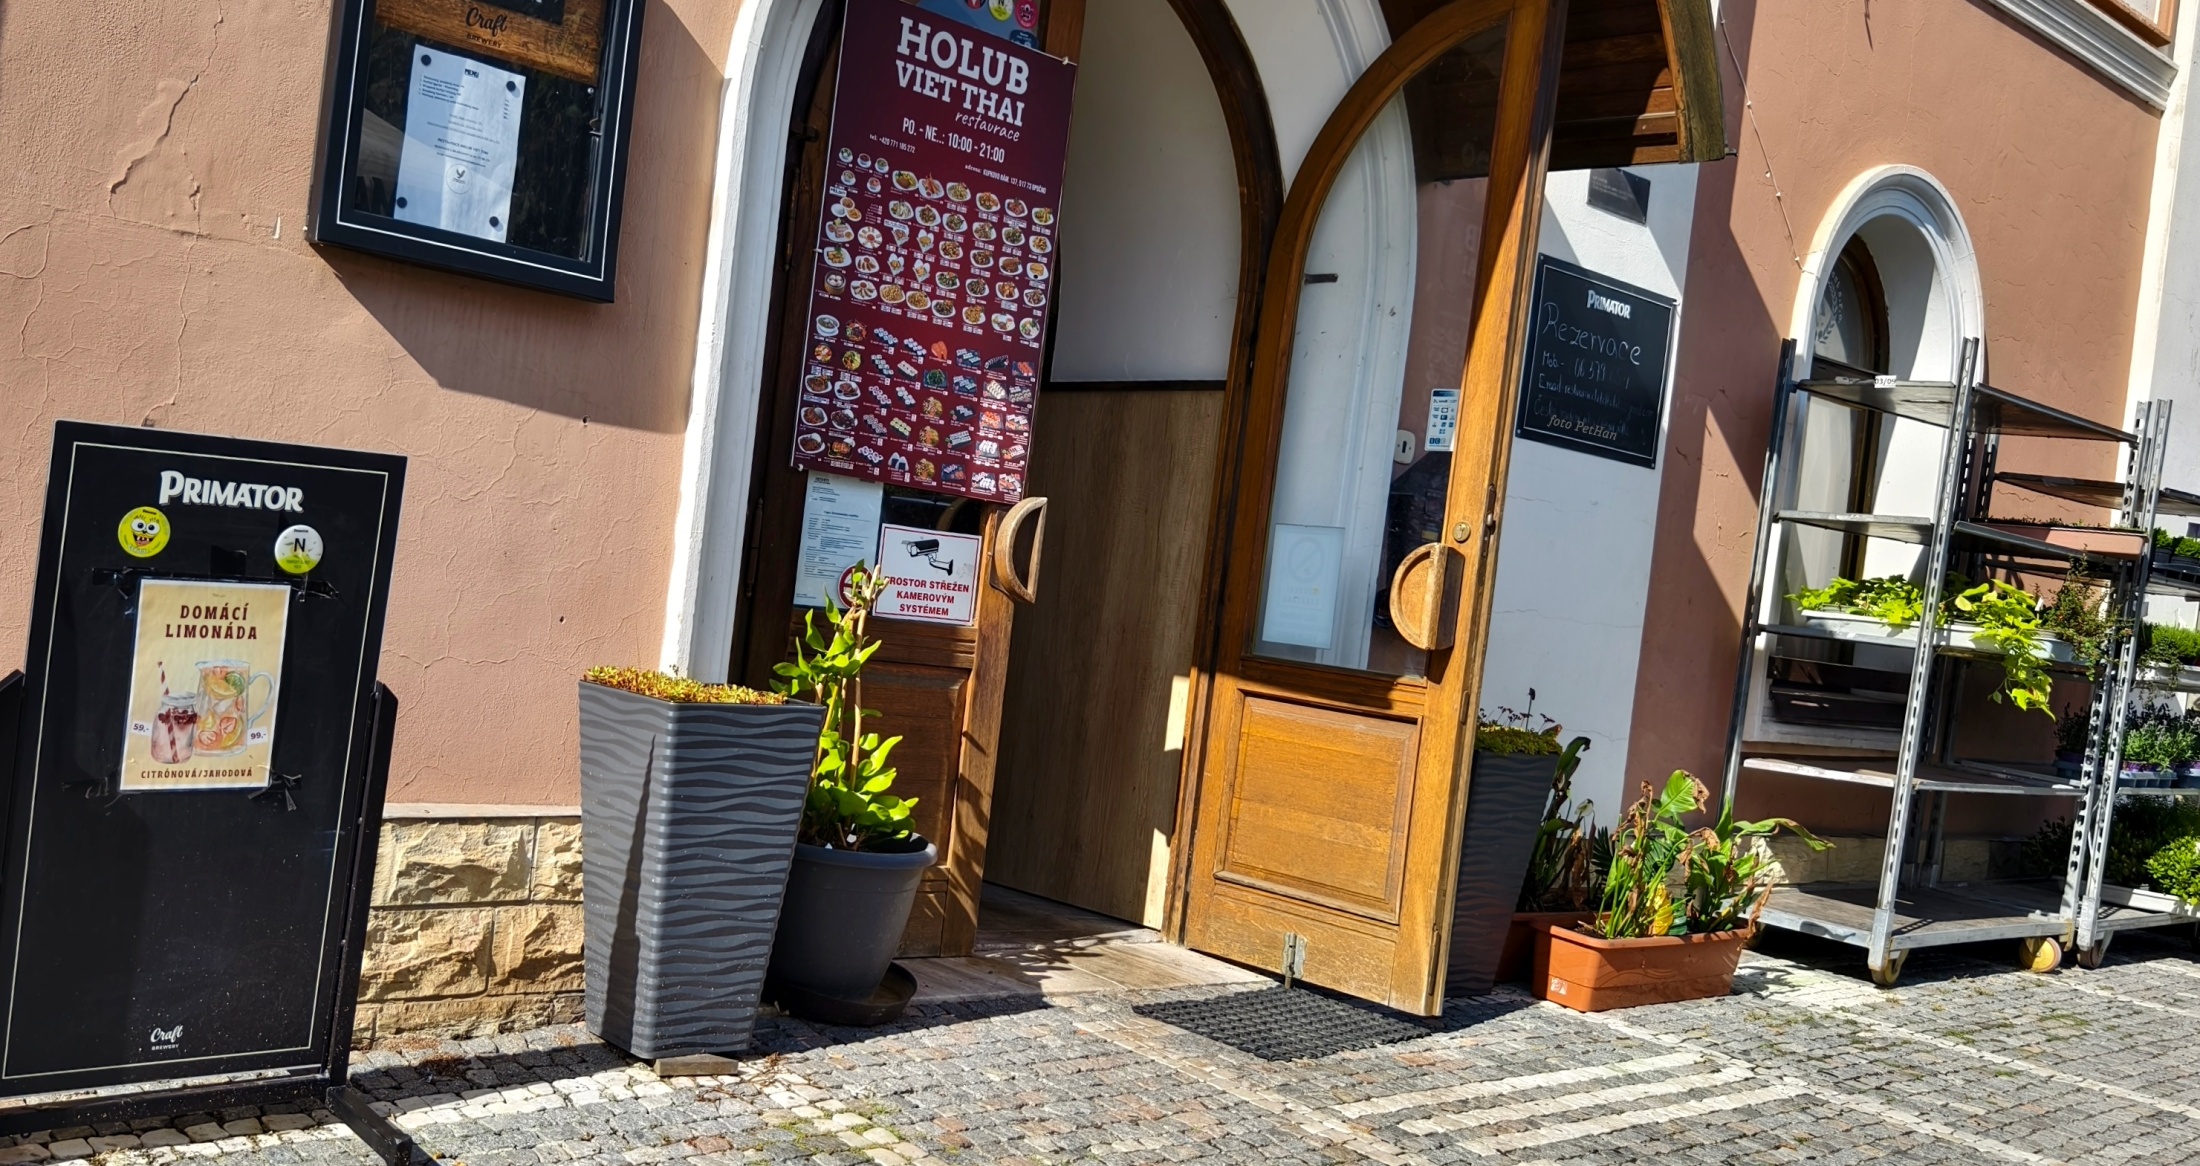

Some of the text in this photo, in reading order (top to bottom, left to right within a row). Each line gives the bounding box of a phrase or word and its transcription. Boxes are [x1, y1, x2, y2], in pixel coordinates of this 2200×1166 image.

[466, 7, 507, 37] Craft
[466, 33, 503, 48] BREWERY
[896, 16, 1029, 95] HOLUB
[895, 59, 1025, 126] VIET THAI
[955, 111, 1020, 142] restaurace
[902, 117, 917, 136] PO.
[947, 131, 973, 153] 10:00
[979, 141, 1005, 163] 21:00
[1586, 290, 1631, 319] PRIMATOR
[1542, 302, 1641, 366] Rezervace
[158, 470, 304, 513] PRIMATOR
[294, 537, 306, 553] N
[929, 579, 970, 593] STŘEŽEN
[896, 590, 955, 604] KAMEROVÝM
[180, 602, 250, 620] DOMÁCÍ
[899, 603, 949, 616] SYSTÉMEM
[165, 621, 258, 640] LIMONÁDA
[141, 766, 253, 779] CITRÓNOVÁ/JAHODOVÁ
[150, 1024, 184, 1043] Craft
[151, 1043, 179, 1051] BREWERY
